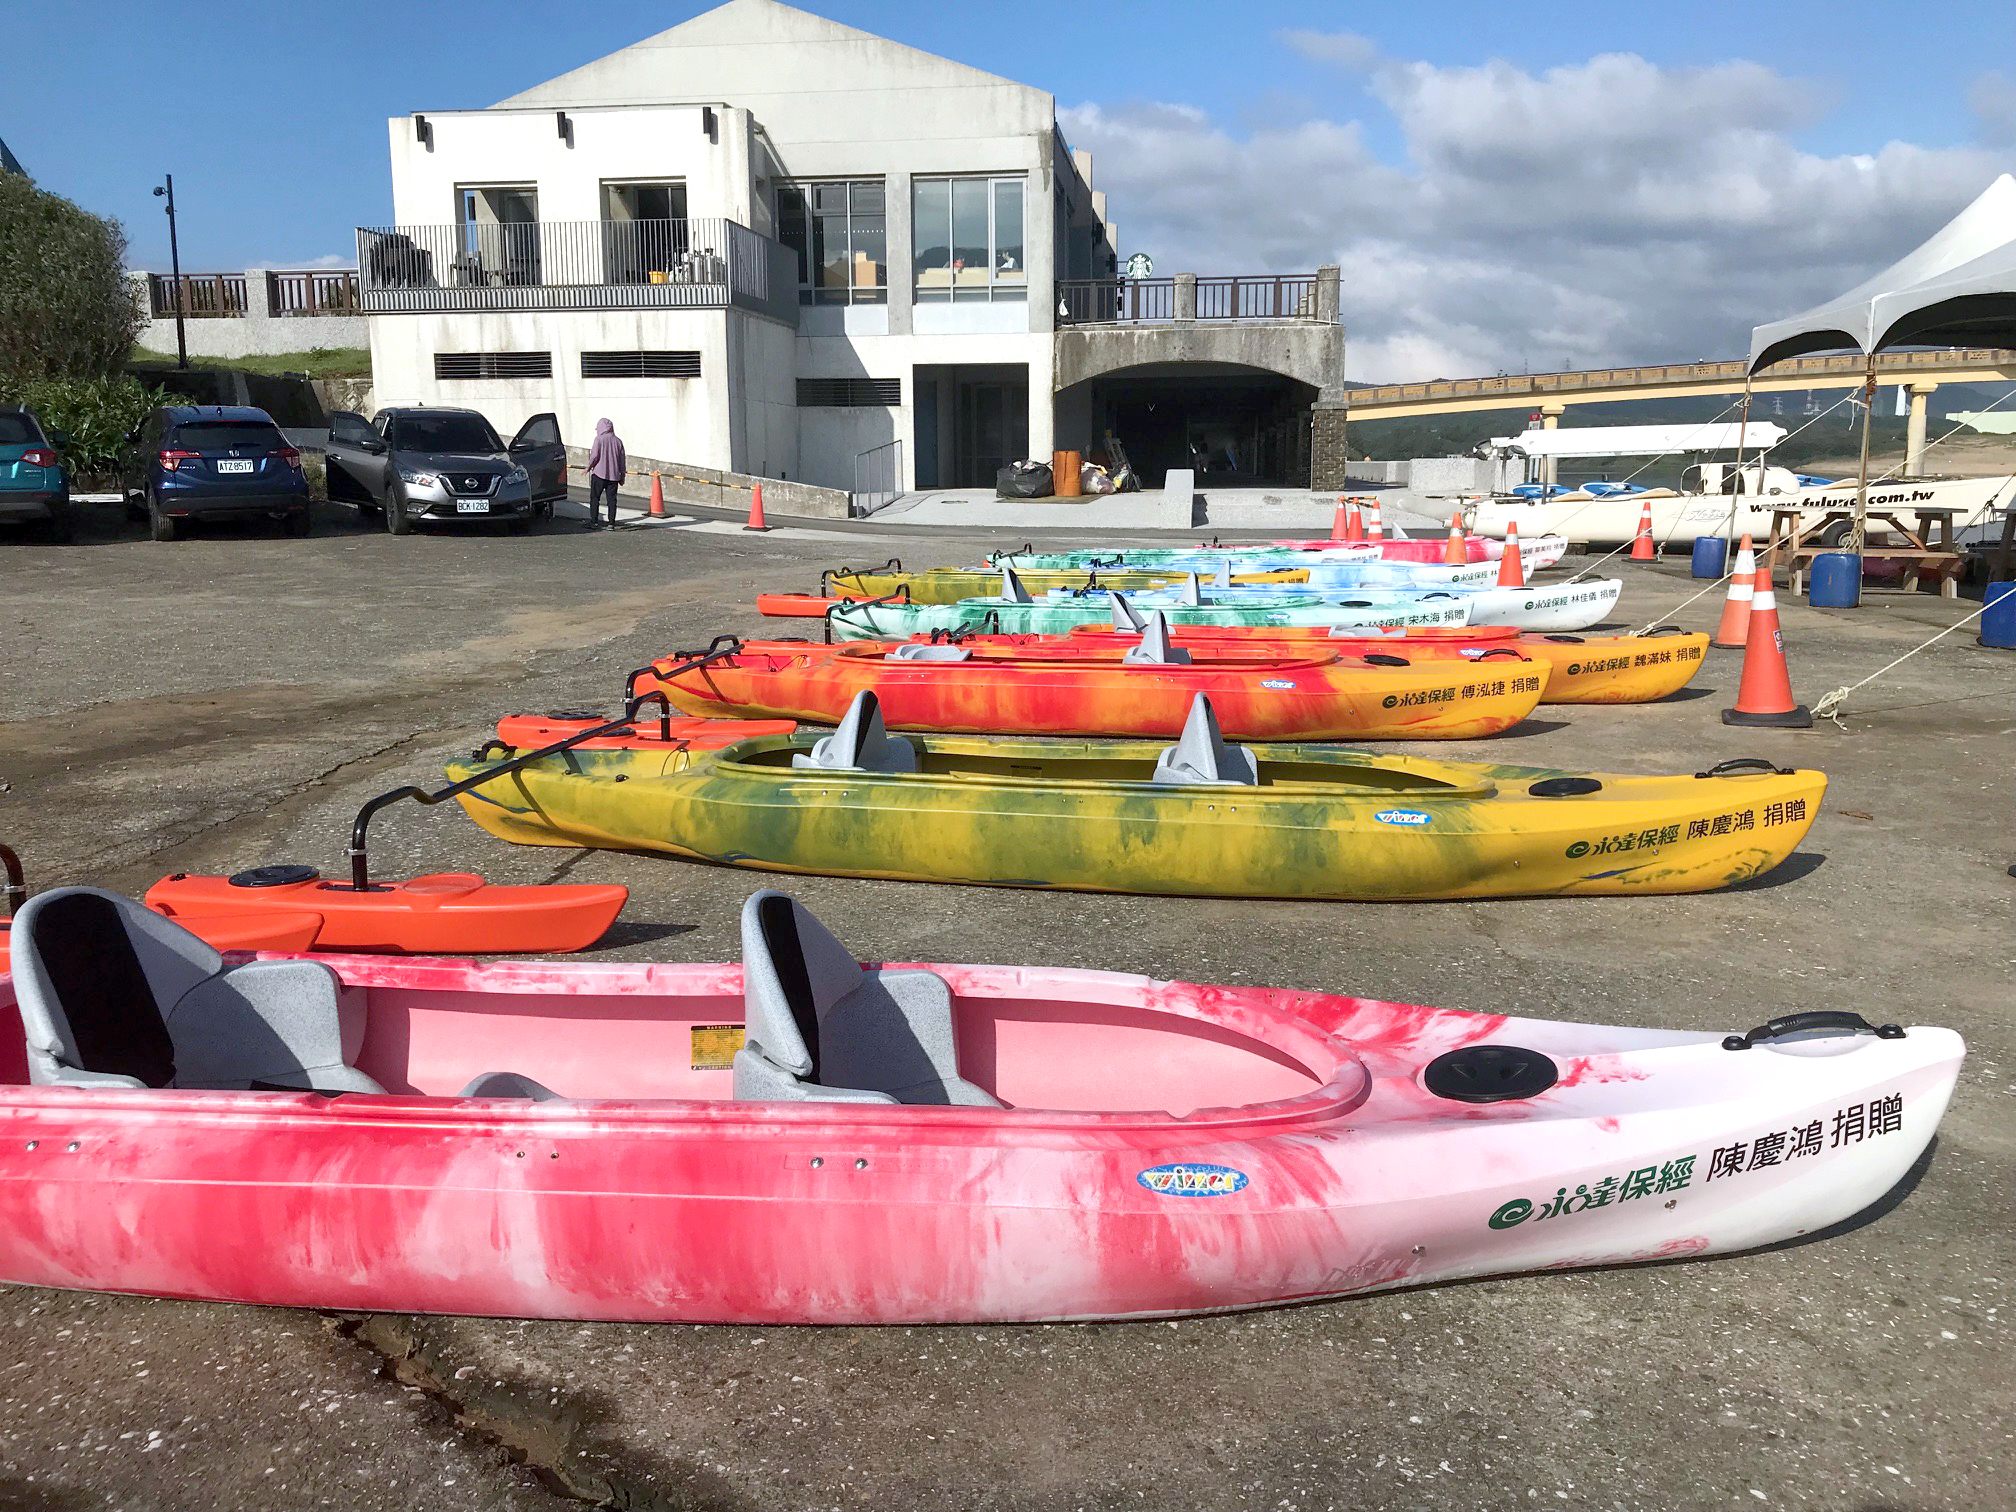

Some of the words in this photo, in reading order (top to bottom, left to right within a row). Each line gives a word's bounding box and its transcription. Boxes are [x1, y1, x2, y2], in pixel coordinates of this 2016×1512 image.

[1600, 588, 1617, 600] 捐贈
[1408, 612, 1440, 625] 宋木海
[1444, 609, 1464, 621] 捐贈
[1634, 651, 1671, 667] 魏滿妹
[1676, 646, 1701, 662] 捐贈
[1461, 681, 1505, 699] 傅泓捷
[1511, 676, 1540, 694] 捐贈
[1591, 824, 1680, 856] 永達保經
[1687, 809, 1755, 840] 陳慶鴻
[1763, 798, 1806, 828] 捐贈
[1533, 1154, 1698, 1222] 永達保經
[1705, 1119, 1824, 1183] 陳慶鴻
[1830, 1093, 1903, 1149] 捐贈
